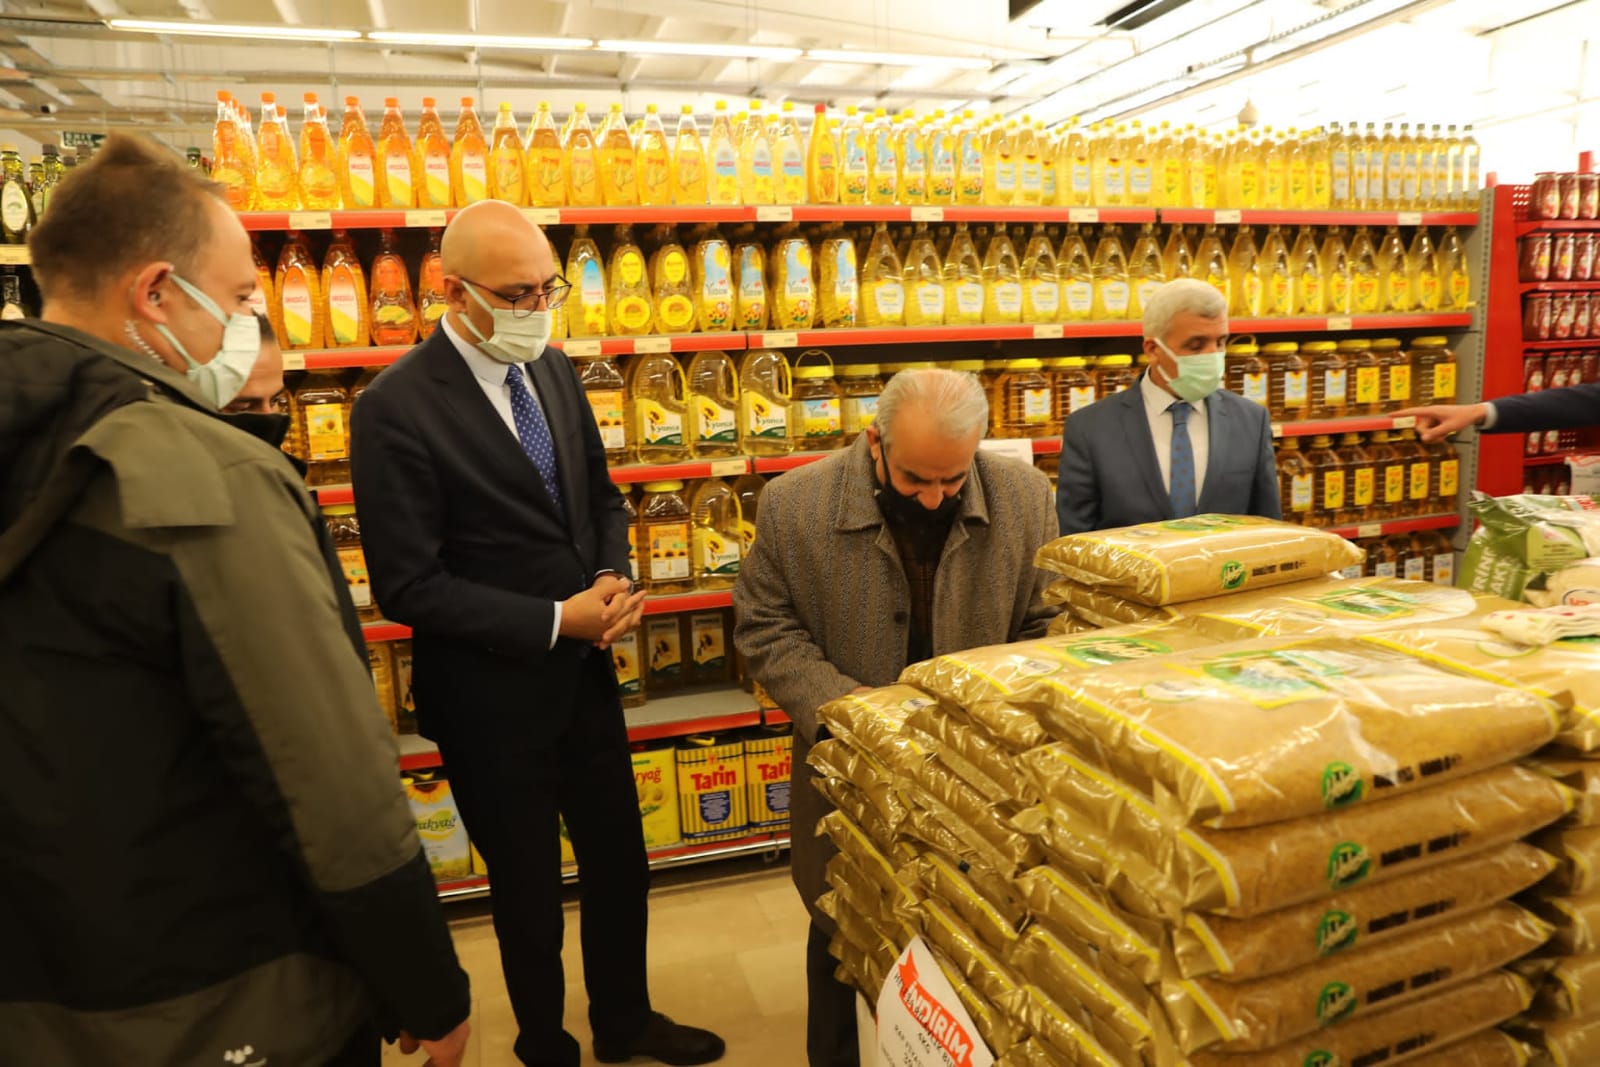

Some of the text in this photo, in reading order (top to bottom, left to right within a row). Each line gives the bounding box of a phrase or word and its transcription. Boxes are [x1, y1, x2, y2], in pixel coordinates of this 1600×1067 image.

[635, 768, 662, 783] ryağ
[690, 765, 737, 790] Tarin
[757, 755, 791, 781] Tari
[904, 981, 969, 1063] İNDİRİM
